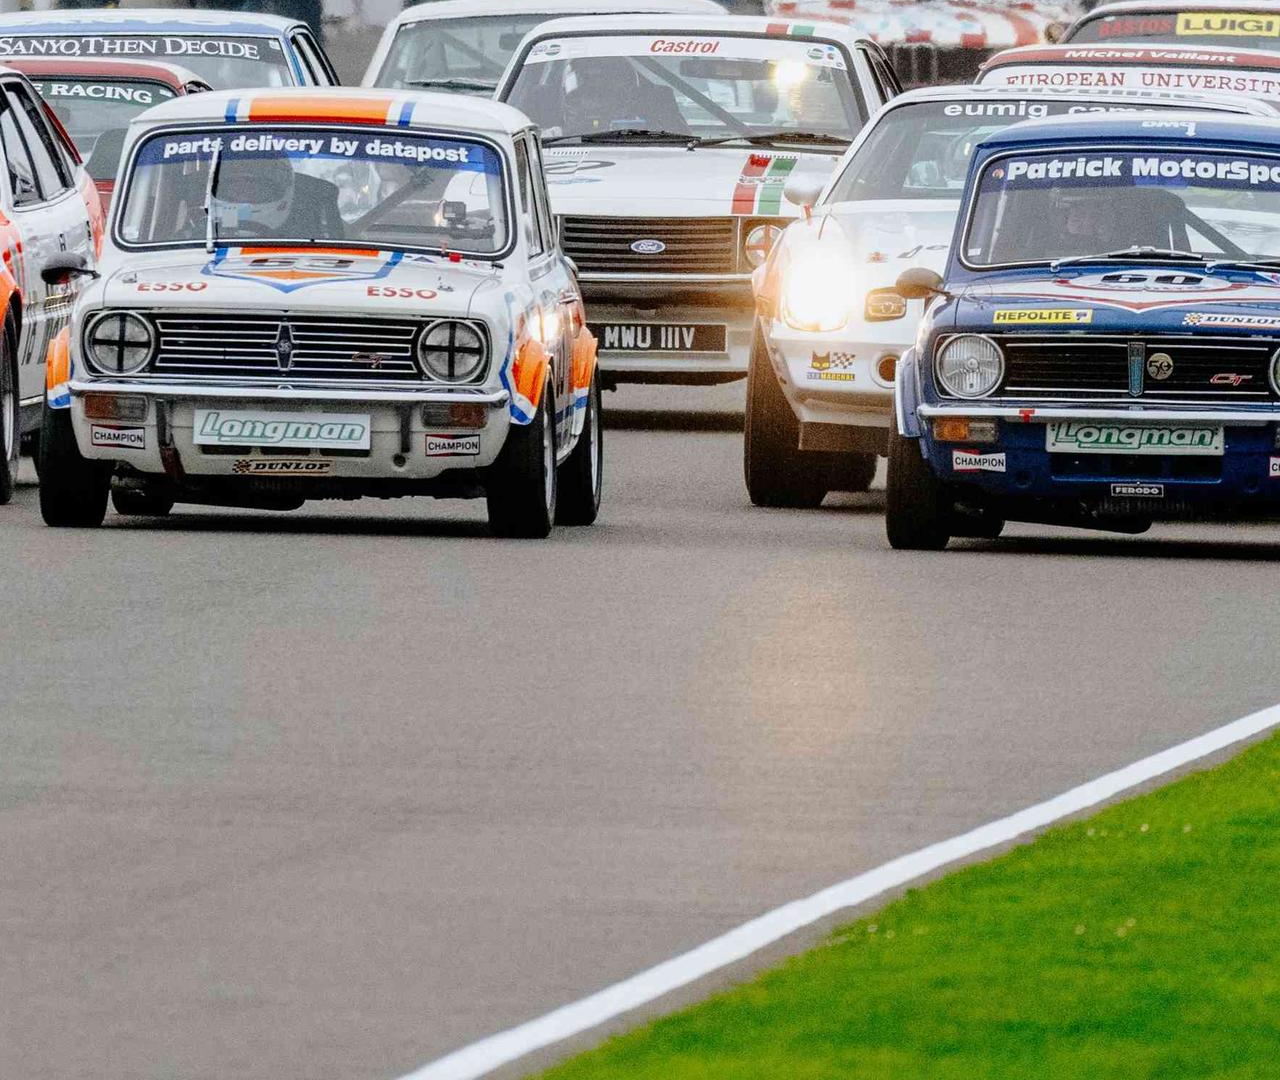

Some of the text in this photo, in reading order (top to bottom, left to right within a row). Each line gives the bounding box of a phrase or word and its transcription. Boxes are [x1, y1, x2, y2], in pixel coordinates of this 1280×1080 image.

[1184, 19, 1273, 32] LUIGI
[163, 38, 261, 60] DECIDE
[651, 40, 720, 54] Castrol
[1065, 50, 1237, 63] Michel Vaillant
[1007, 73, 1125, 87] EUROPEAN
[50, 83, 152, 104] RACING
[944, 101, 1048, 118] eumig
[164, 136, 468, 163] parts delivery by datapost
[1008, 158, 1121, 181] Patrick
[1100, 273, 1204, 285] 60
[137, 282, 207, 291] ESSO
[367, 286, 437, 299] ESSO
[995, 311, 1073, 322] HEPOLITE
[604, 326, 651, 348] MWU
[200, 413, 365, 444] Longman
[93, 431, 143, 443] CHAMPION
[1052, 423, 1220, 451] Longman
[427, 440, 479, 451] CHAMPION
[254, 462, 332, 472] DUNLOP
[955, 456, 1004, 467] CHAMPION
[1116, 487, 1158, 495] FERODO
